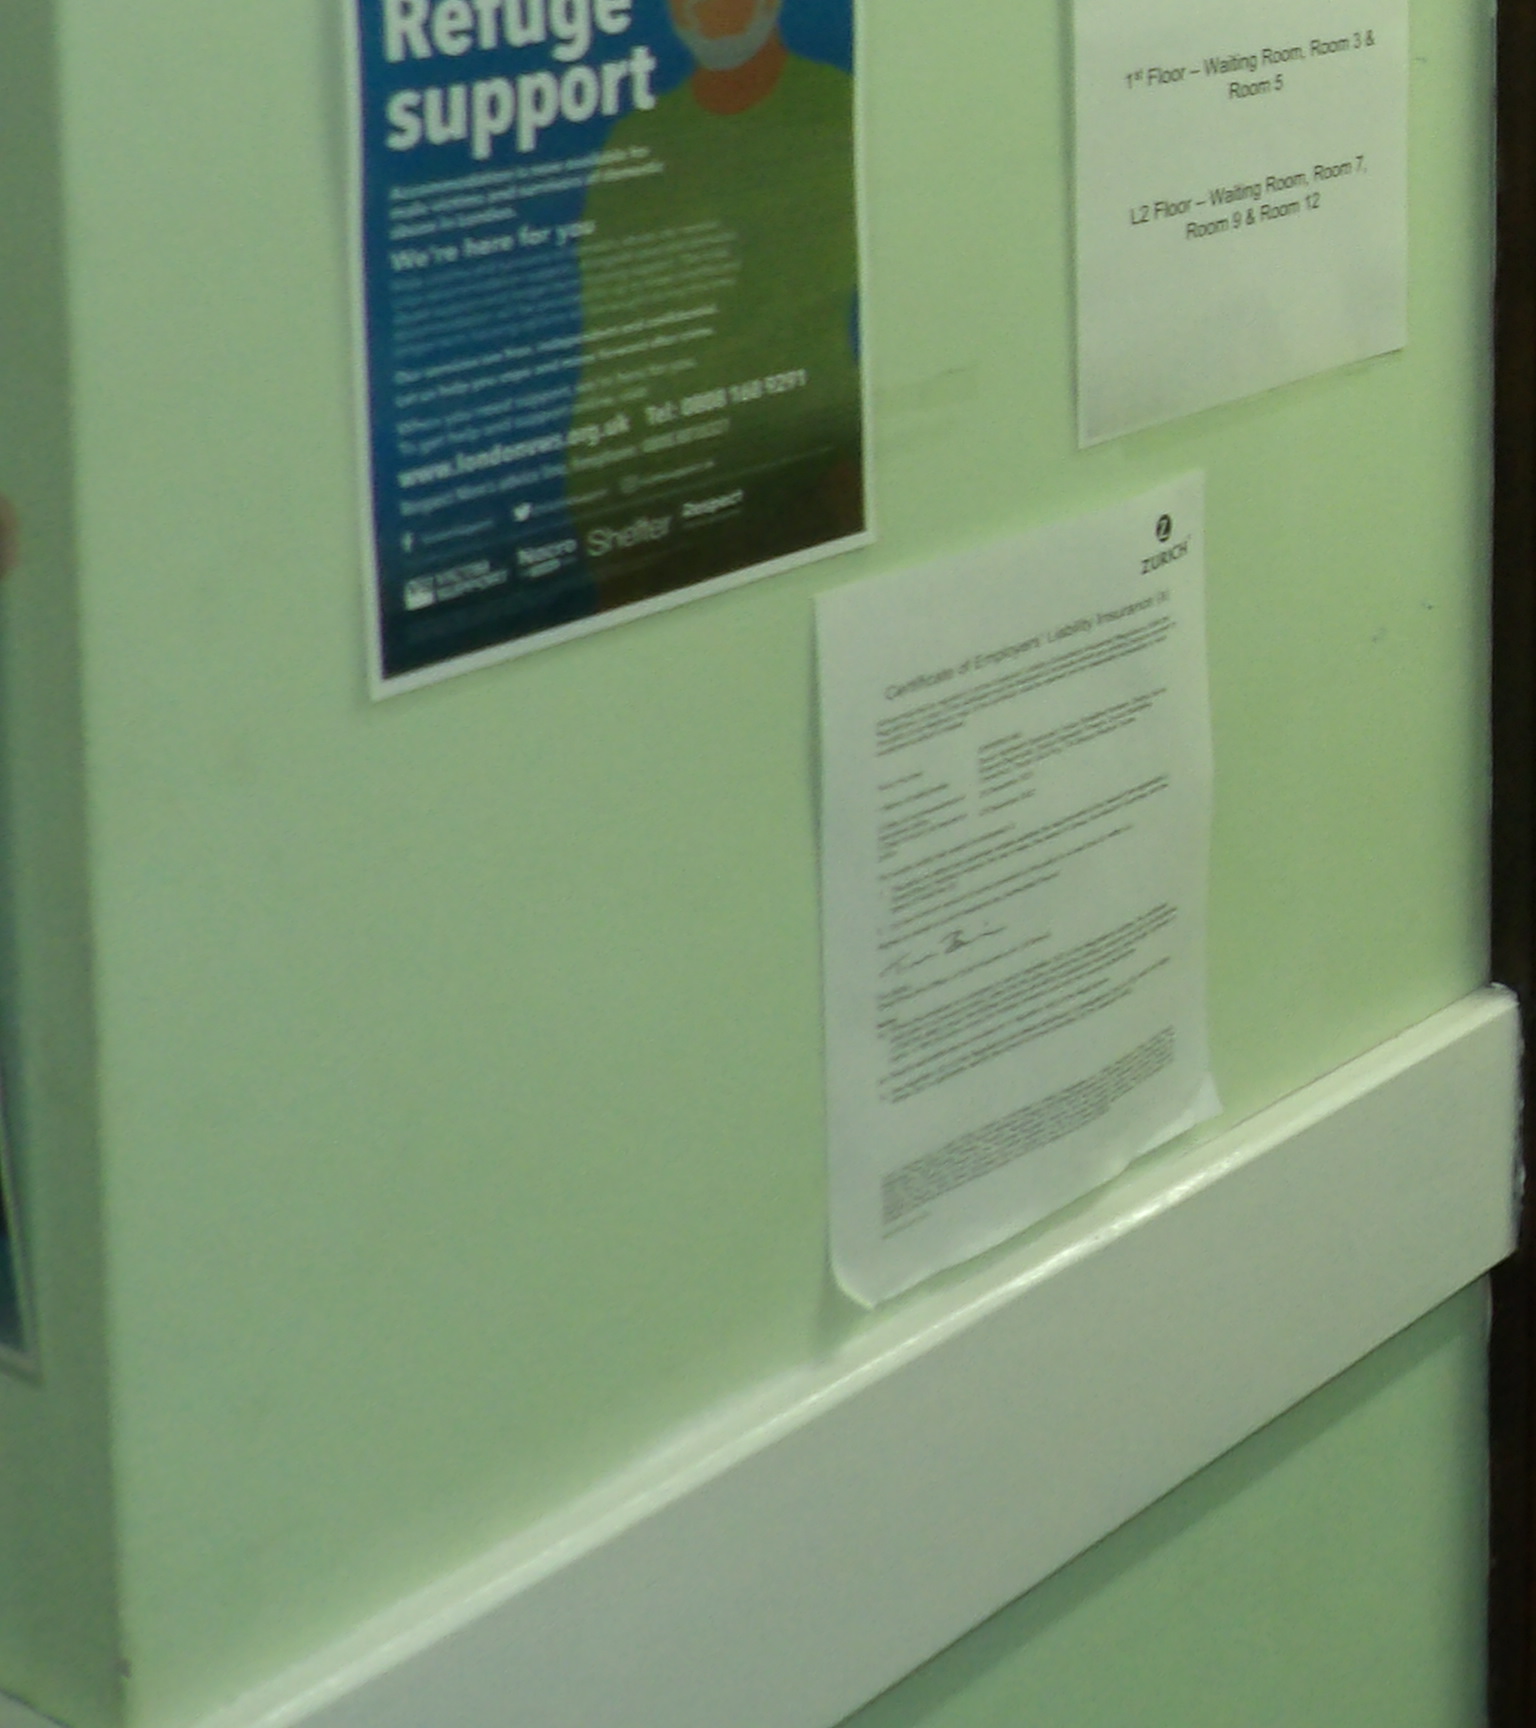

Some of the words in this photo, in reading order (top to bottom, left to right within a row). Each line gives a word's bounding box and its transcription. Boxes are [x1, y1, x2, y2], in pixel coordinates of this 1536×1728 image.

[1147, 66, 1186, 86] Floor
[1203, 54, 1257, 76] Waiting
[1310, 37, 1349, 56] Room
[1353, 32, 1362, 49] 3
[1365, 29, 1375, 47] &
[386, 43, 657, 161] support
[1229, 80, 1271, 100] Room
[1274, 74, 1284, 92] 5
[1129, 204, 1150, 226] L2
[1153, 199, 1192, 220] Floor
[1209, 183, 1262, 206] Waiting
[1265, 172, 1309, 194] Room,
[1313, 161, 1352, 181] Room
[1185, 219, 1230, 241] Room
[1232, 211, 1242, 229] 9
[1245, 207, 1255, 225] &
[1260, 201, 1300, 222] Room
[1304, 192, 1321, 211] 12
[462, 235, 514, 257] here
[518, 224, 550, 246] for
[1140, 539, 1188, 576] ZURICH
